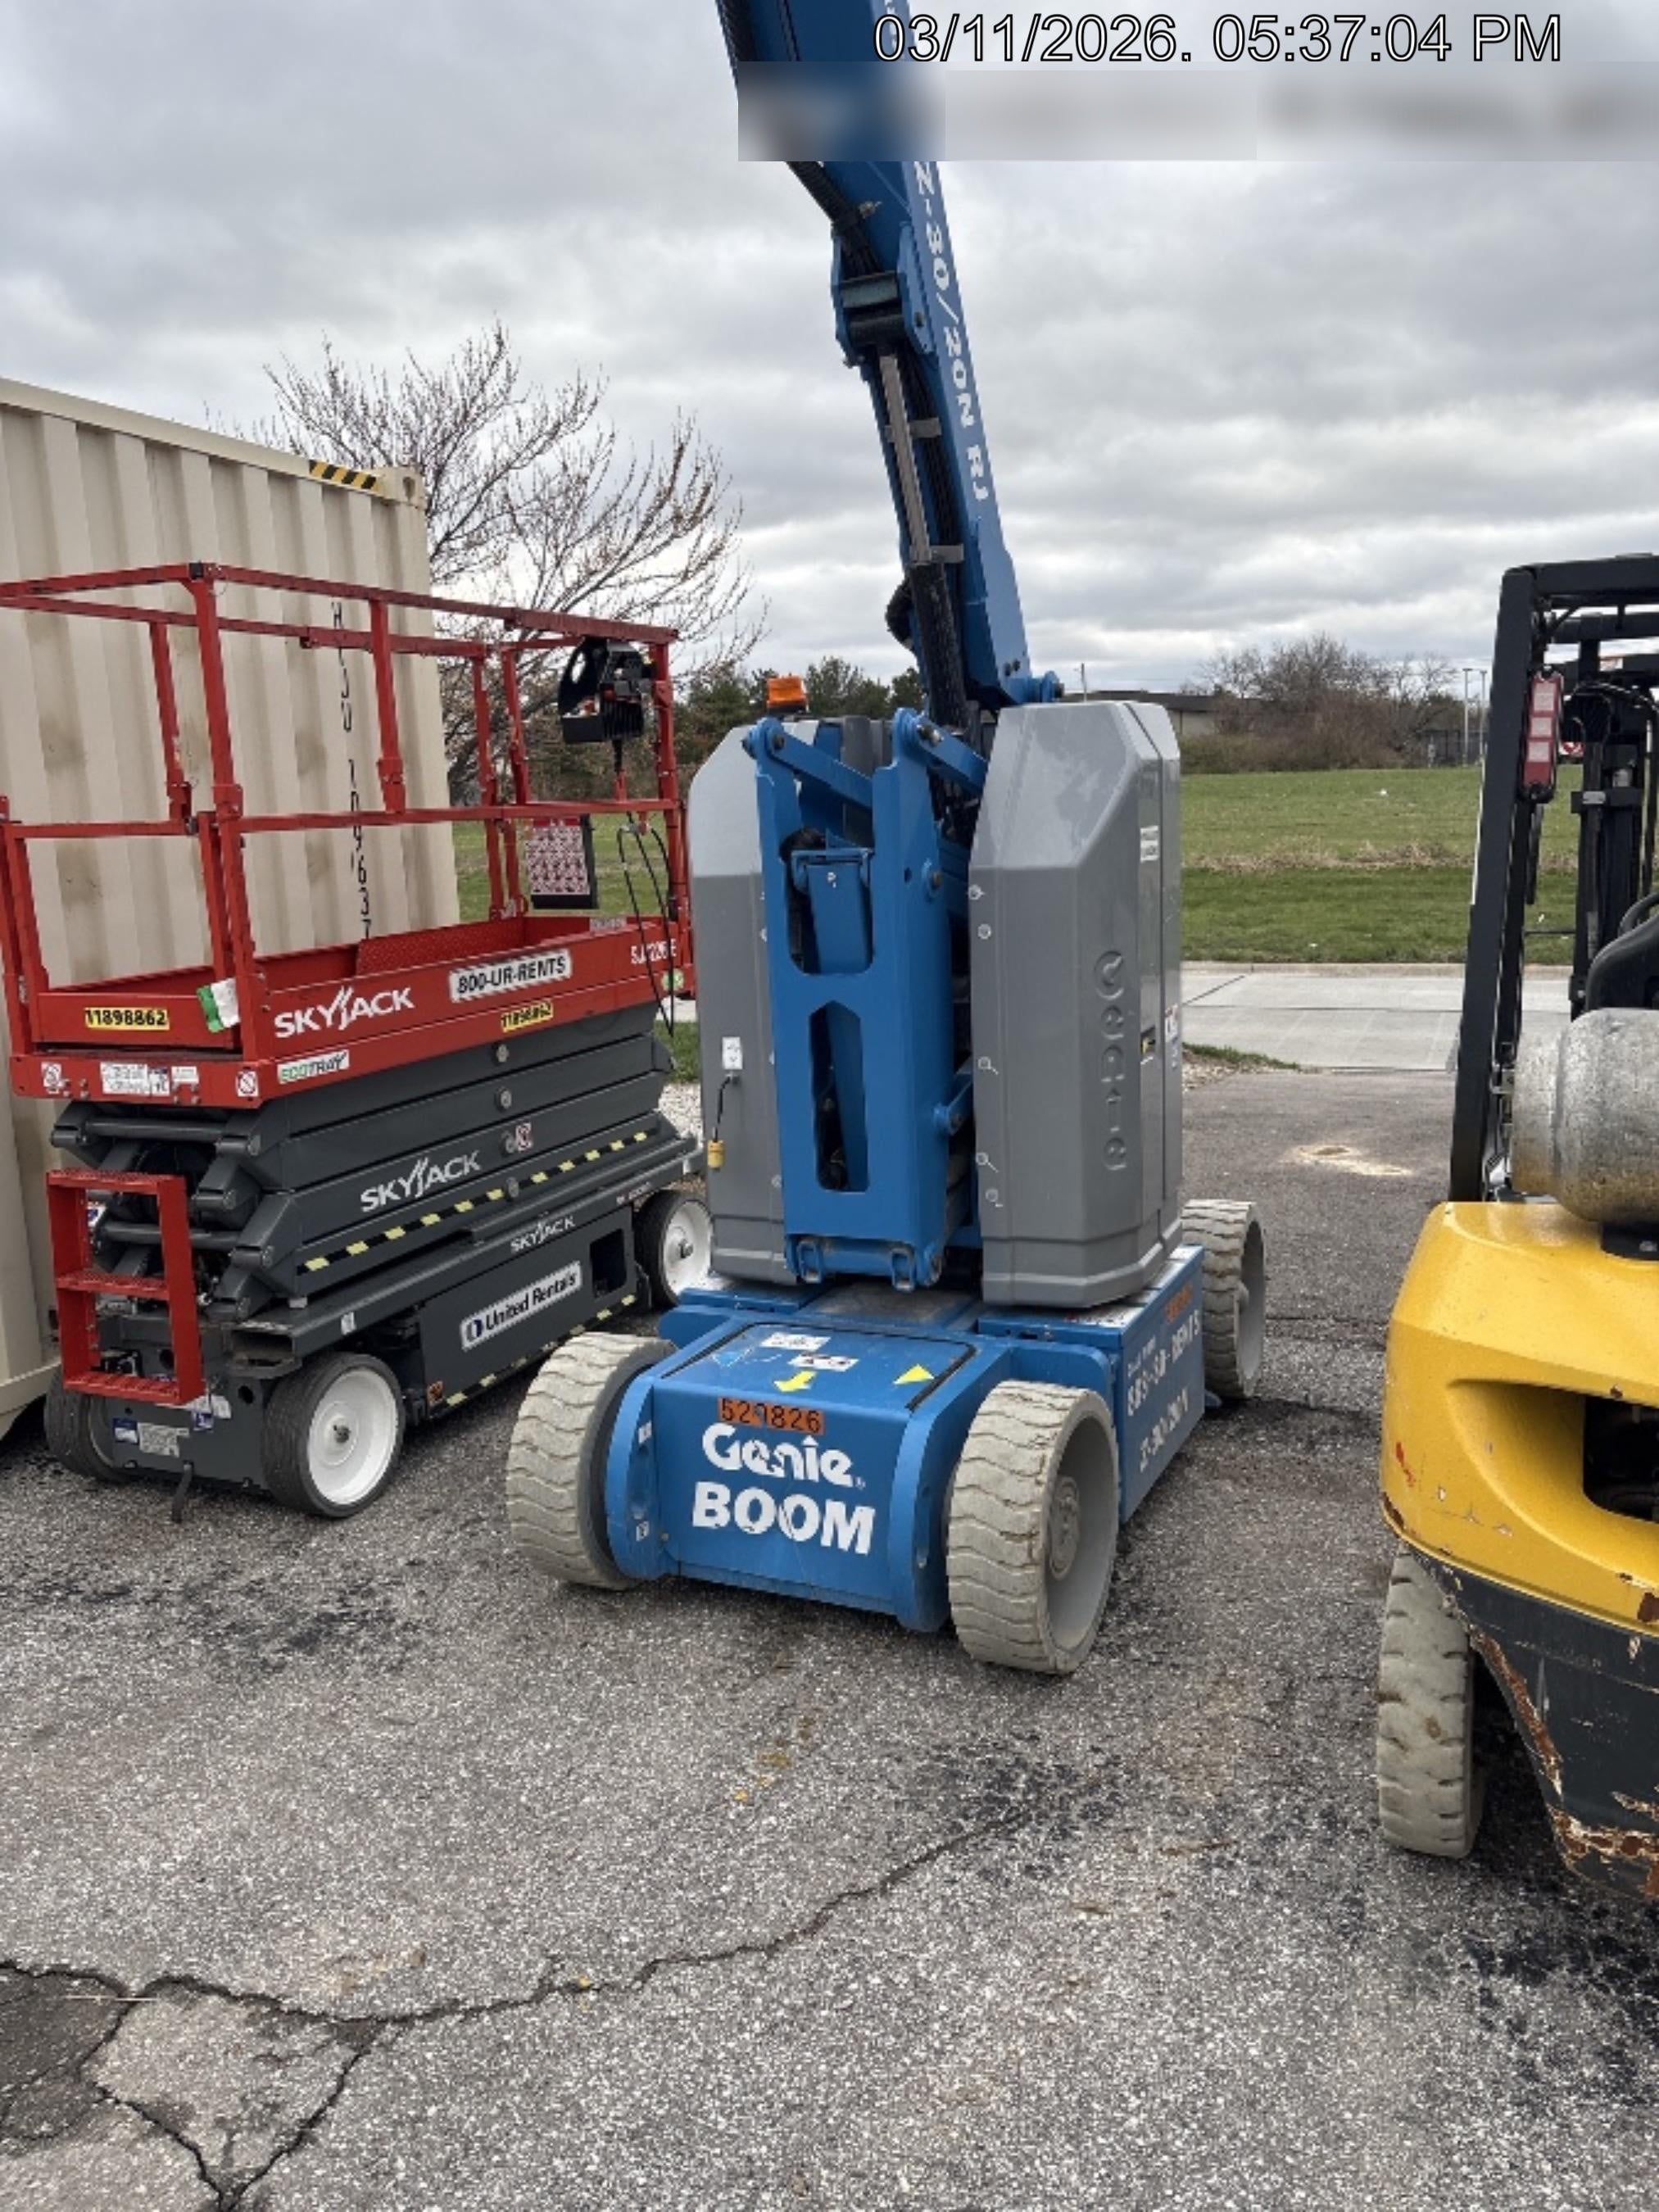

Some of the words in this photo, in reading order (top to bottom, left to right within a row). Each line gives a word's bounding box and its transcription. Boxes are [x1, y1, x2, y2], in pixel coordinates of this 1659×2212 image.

[968, 444, 989, 501] RJ
[457, 955, 566, 994] 800-UR-RENTS
[85, 1009, 168, 1026] 11898862
[274, 985, 415, 1038] SKYJACK
[360, 1149, 481, 1213] SKYJACK
[510, 1216, 575, 1252] SKYJACK
[486, 1292, 529, 1331] United
[532, 1272, 577, 1304] Rentals
[702, 1422, 854, 1488] Genie
[692, 1481, 876, 1555] BOOM
